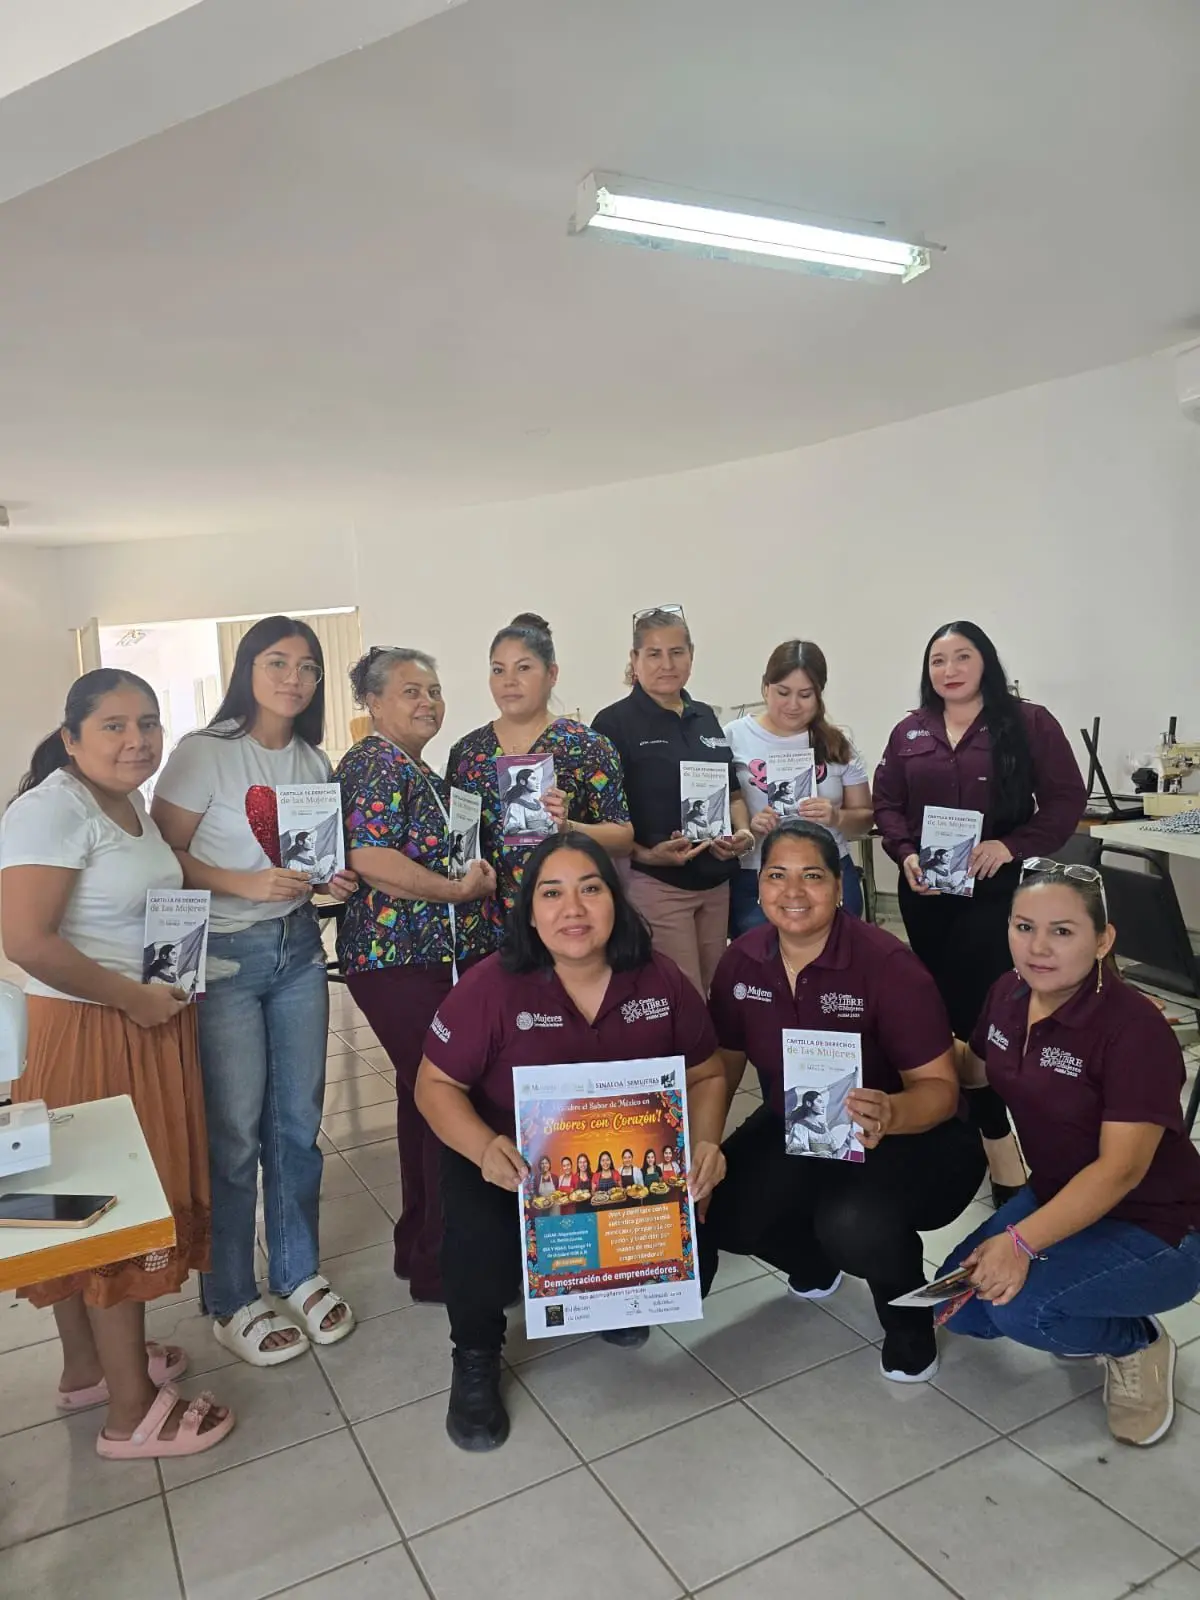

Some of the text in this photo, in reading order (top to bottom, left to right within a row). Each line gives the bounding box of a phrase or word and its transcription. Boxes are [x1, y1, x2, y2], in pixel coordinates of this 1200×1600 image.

[747, 985, 772, 998] Mujeres
[641, 998, 669, 1012] LIBRE
[838, 998, 864, 1006] LIBRE
[533, 1013, 563, 1023] Mujeres
[787, 1045, 856, 1059] de las Mujeres
[1060, 1056, 1083, 1068] LIBRE
[595, 1080, 623, 1089] SINALOA
[589, 1101, 608, 1110] Sabor
[609, 1100, 617, 1108] de
[617, 1098, 641, 1107] México
[590, 1118, 609, 1129] con
[544, 1265, 679, 1288] Demostración de emprendedores.
